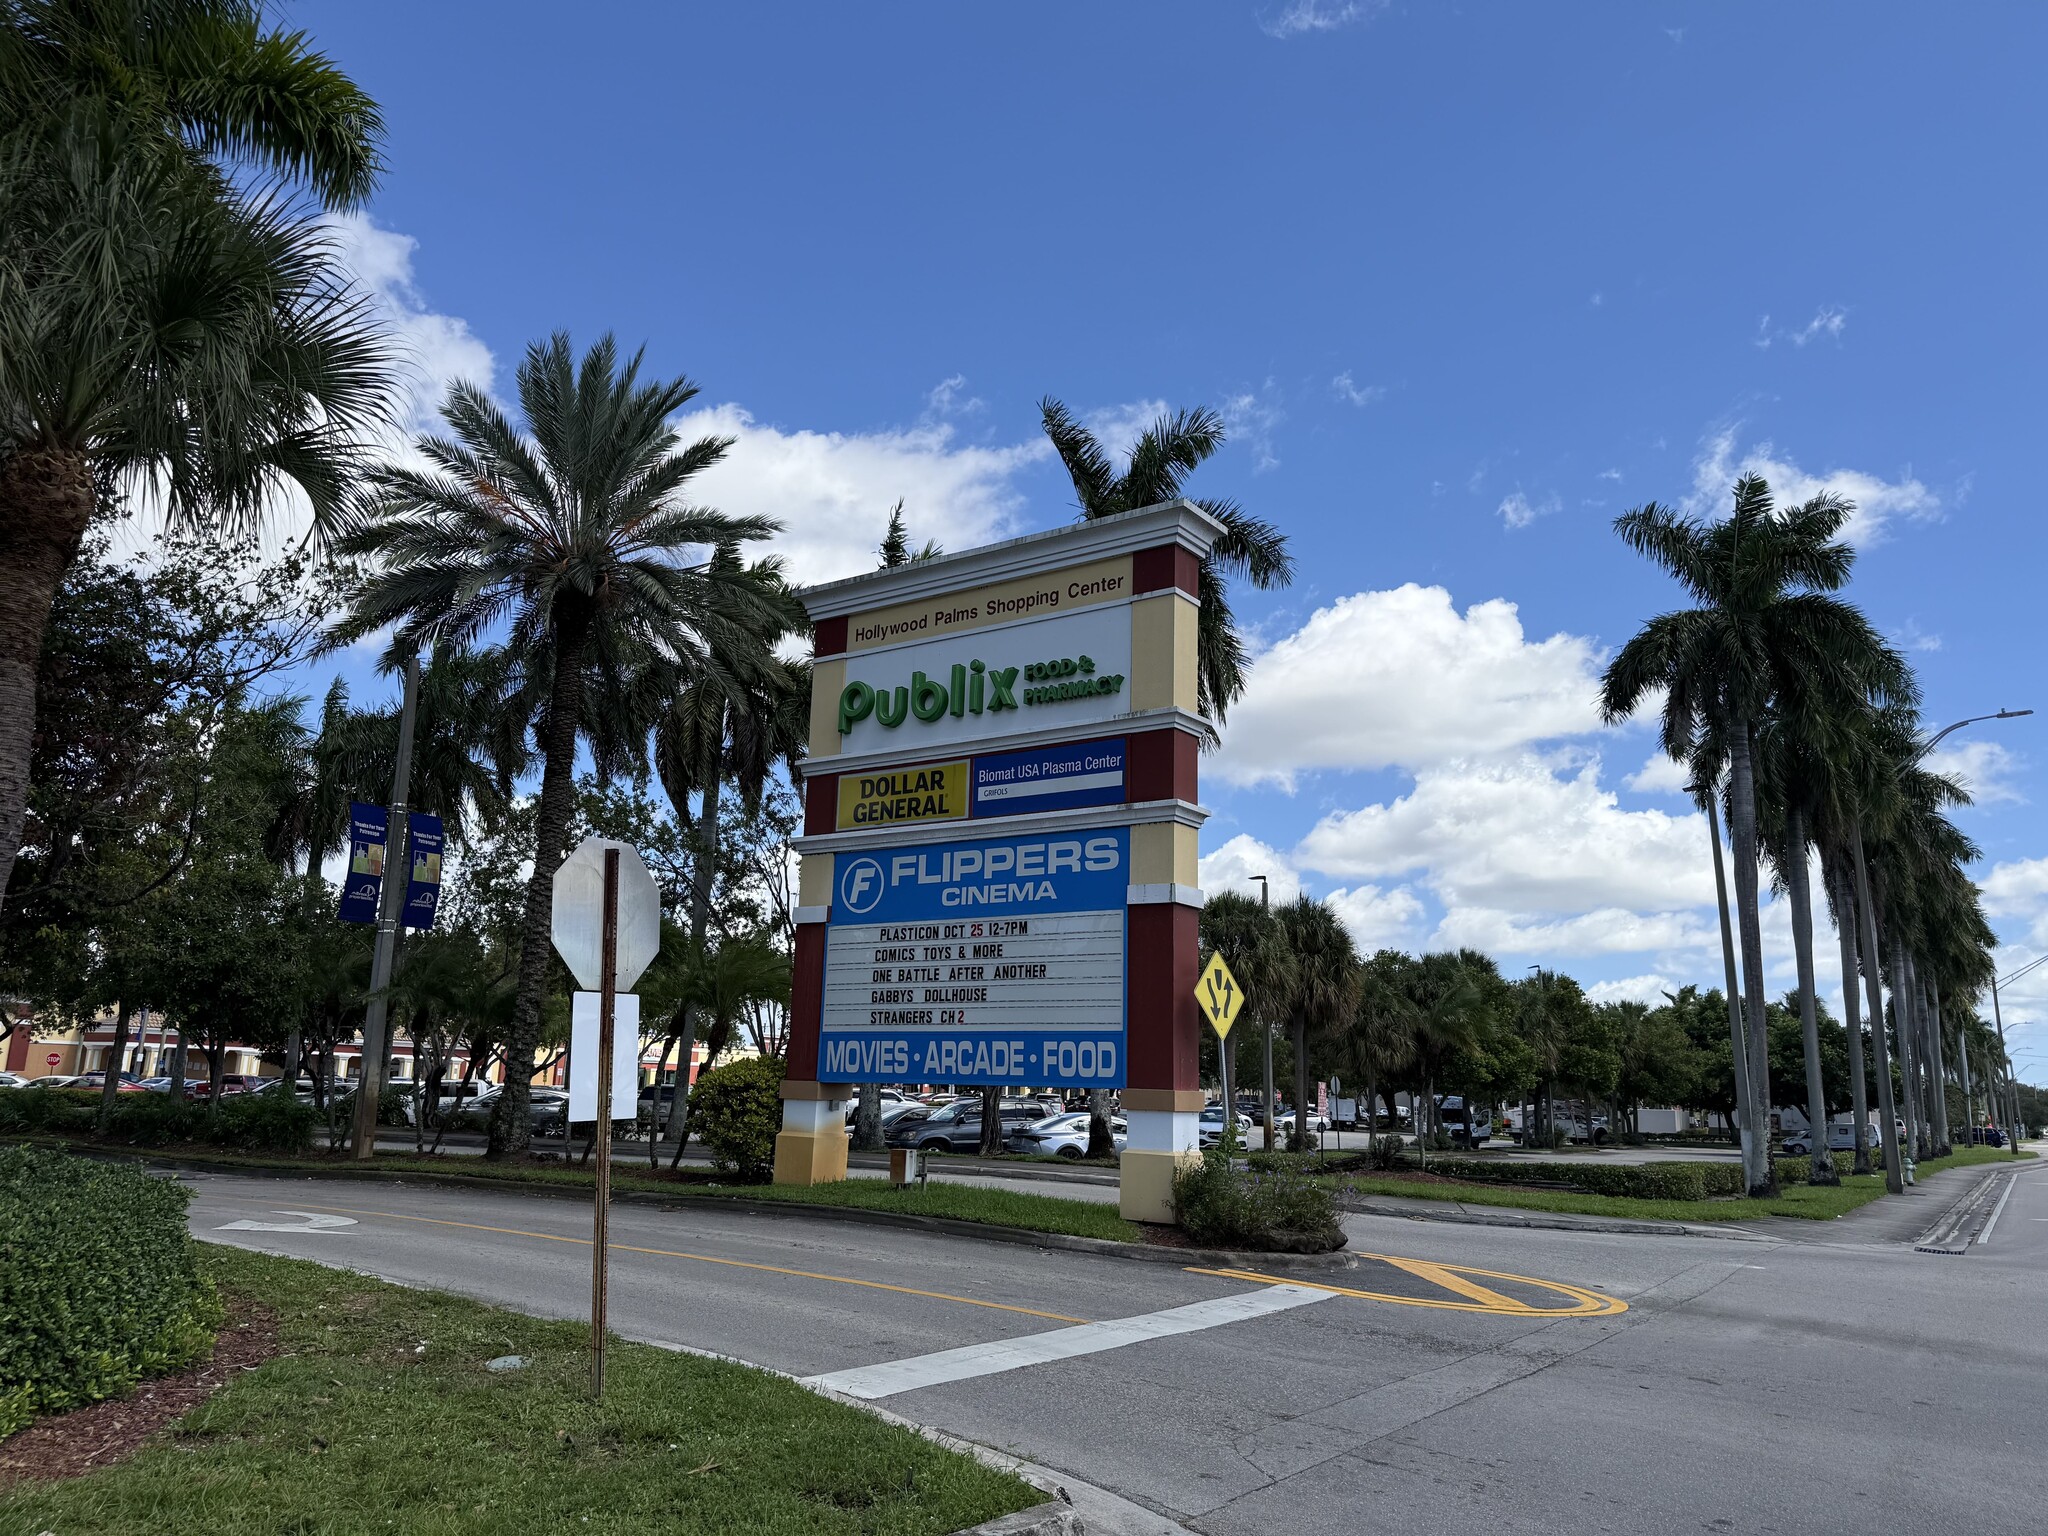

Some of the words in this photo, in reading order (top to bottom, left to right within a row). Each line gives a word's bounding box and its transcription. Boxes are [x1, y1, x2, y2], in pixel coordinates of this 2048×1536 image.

[856, 615, 927, 642] Hollywood
[935, 607, 978, 626] Palms
[986, 588, 1059, 616] Shopping
[1068, 576, 1124, 599] Center
[1024, 658, 1078, 682] FOOD
[1078, 654, 1095, 674] &
[838, 659, 1020, 734] Publix
[1023, 674, 1125, 706] PHARMACY
[978, 766, 1015, 783] Biomat
[1017, 763, 1039, 778] USA
[1042, 759, 1082, 775] Plasma
[1085, 755, 1122, 770] Center
[860, 770, 945, 799] DOLLAR
[983, 787, 1008, 797] GRIFOLS
[853, 793, 950, 823] GENERAL
[891, 837, 1120, 887] FLIPPERS
[849, 867, 876, 904] F
[941, 880, 1058, 907] CINEMA
[880, 926, 939, 941] PLASTICON
[944, 925, 966, 939] OCT
[970, 924, 984, 937] 25
[989, 921, 1029, 936] 12-7PM
[874, 948, 915, 962] COMICS
[923, 947, 951, 961] TOYS
[958, 946, 966, 959] &
[972, 944, 1004, 958] MORE
[872, 969, 892, 983] ONE
[899, 967, 940, 982] BATTLE
[949, 966, 984, 980] AFTER
[993, 964, 1047, 979] ANOTHER
[871, 989, 914, 1003] GABBYS
[924, 987, 988, 1002] DOLLHOUSE
[870, 1010, 933, 1024] STRANGERS
[940, 1010, 955, 1023] CH
[958, 1010, 965, 1023] 2
[825, 1040, 910, 1074] MOVIES
[923, 1040, 1025, 1076] ARCADE
[1043, 1041, 1117, 1078] FOOD
